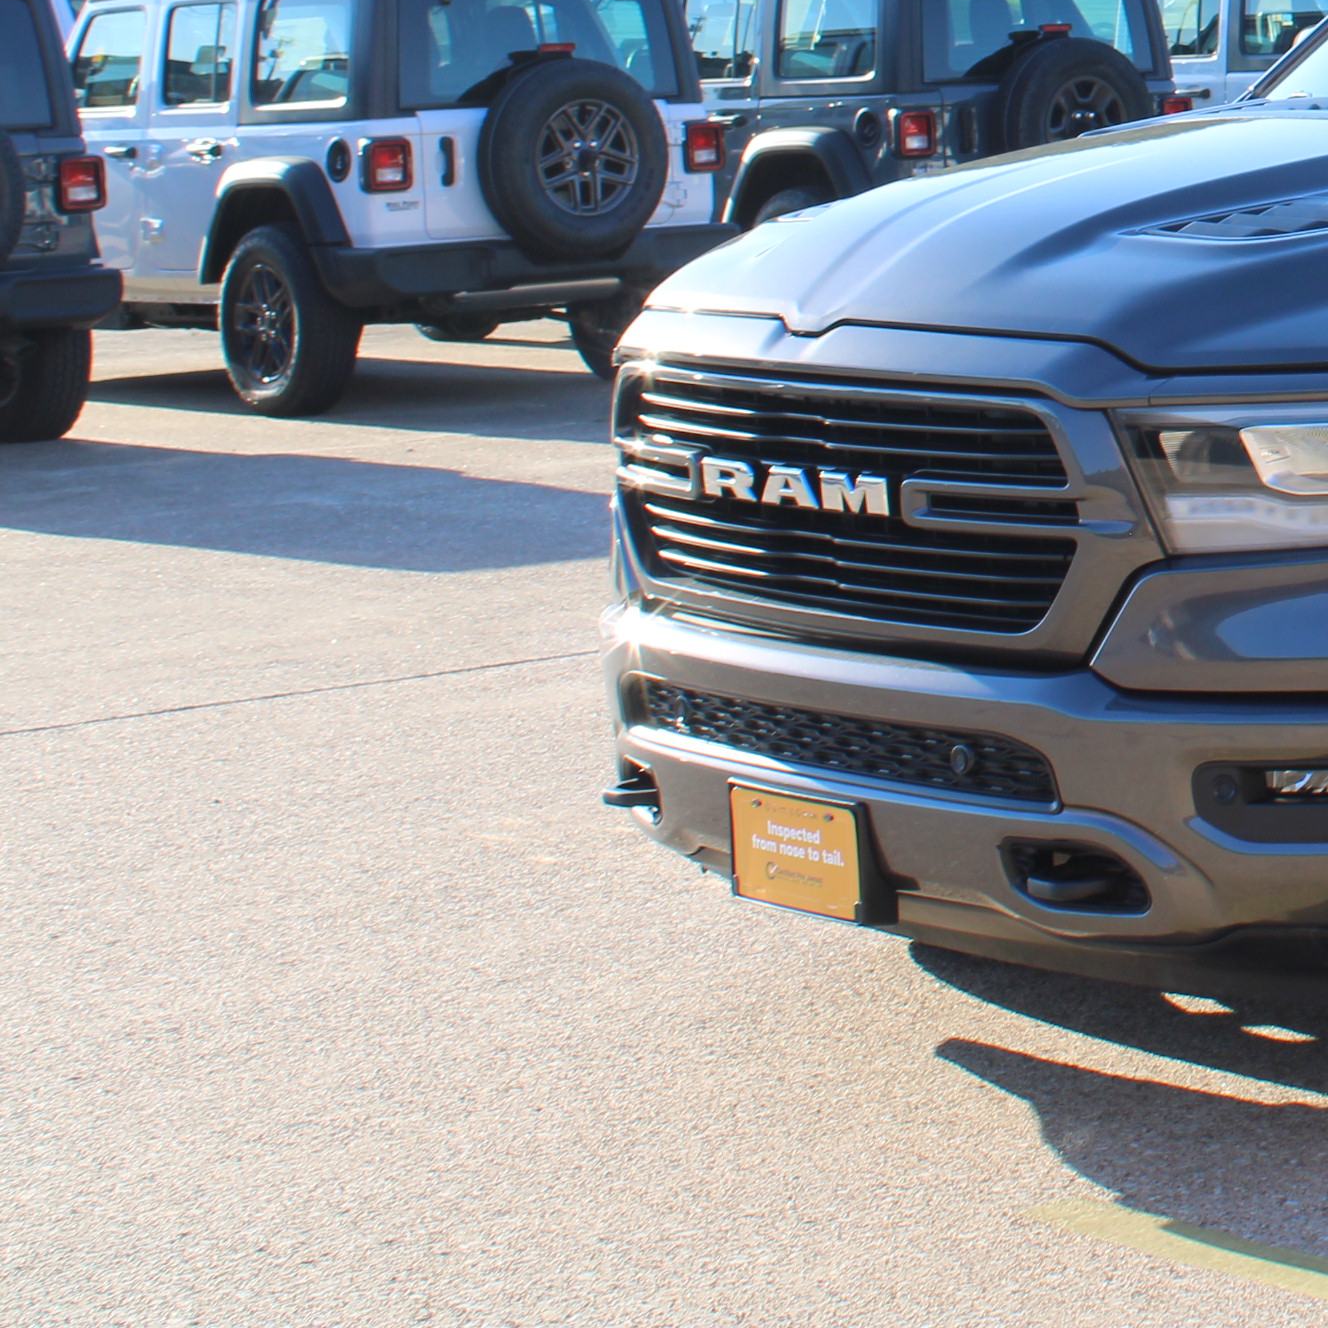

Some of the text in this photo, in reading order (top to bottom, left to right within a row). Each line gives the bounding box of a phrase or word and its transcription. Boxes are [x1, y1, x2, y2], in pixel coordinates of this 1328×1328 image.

[701, 456, 890, 517] RAM
[767, 820, 820, 844] Inspected
[752, 834, 845, 866] from nose to tail.
